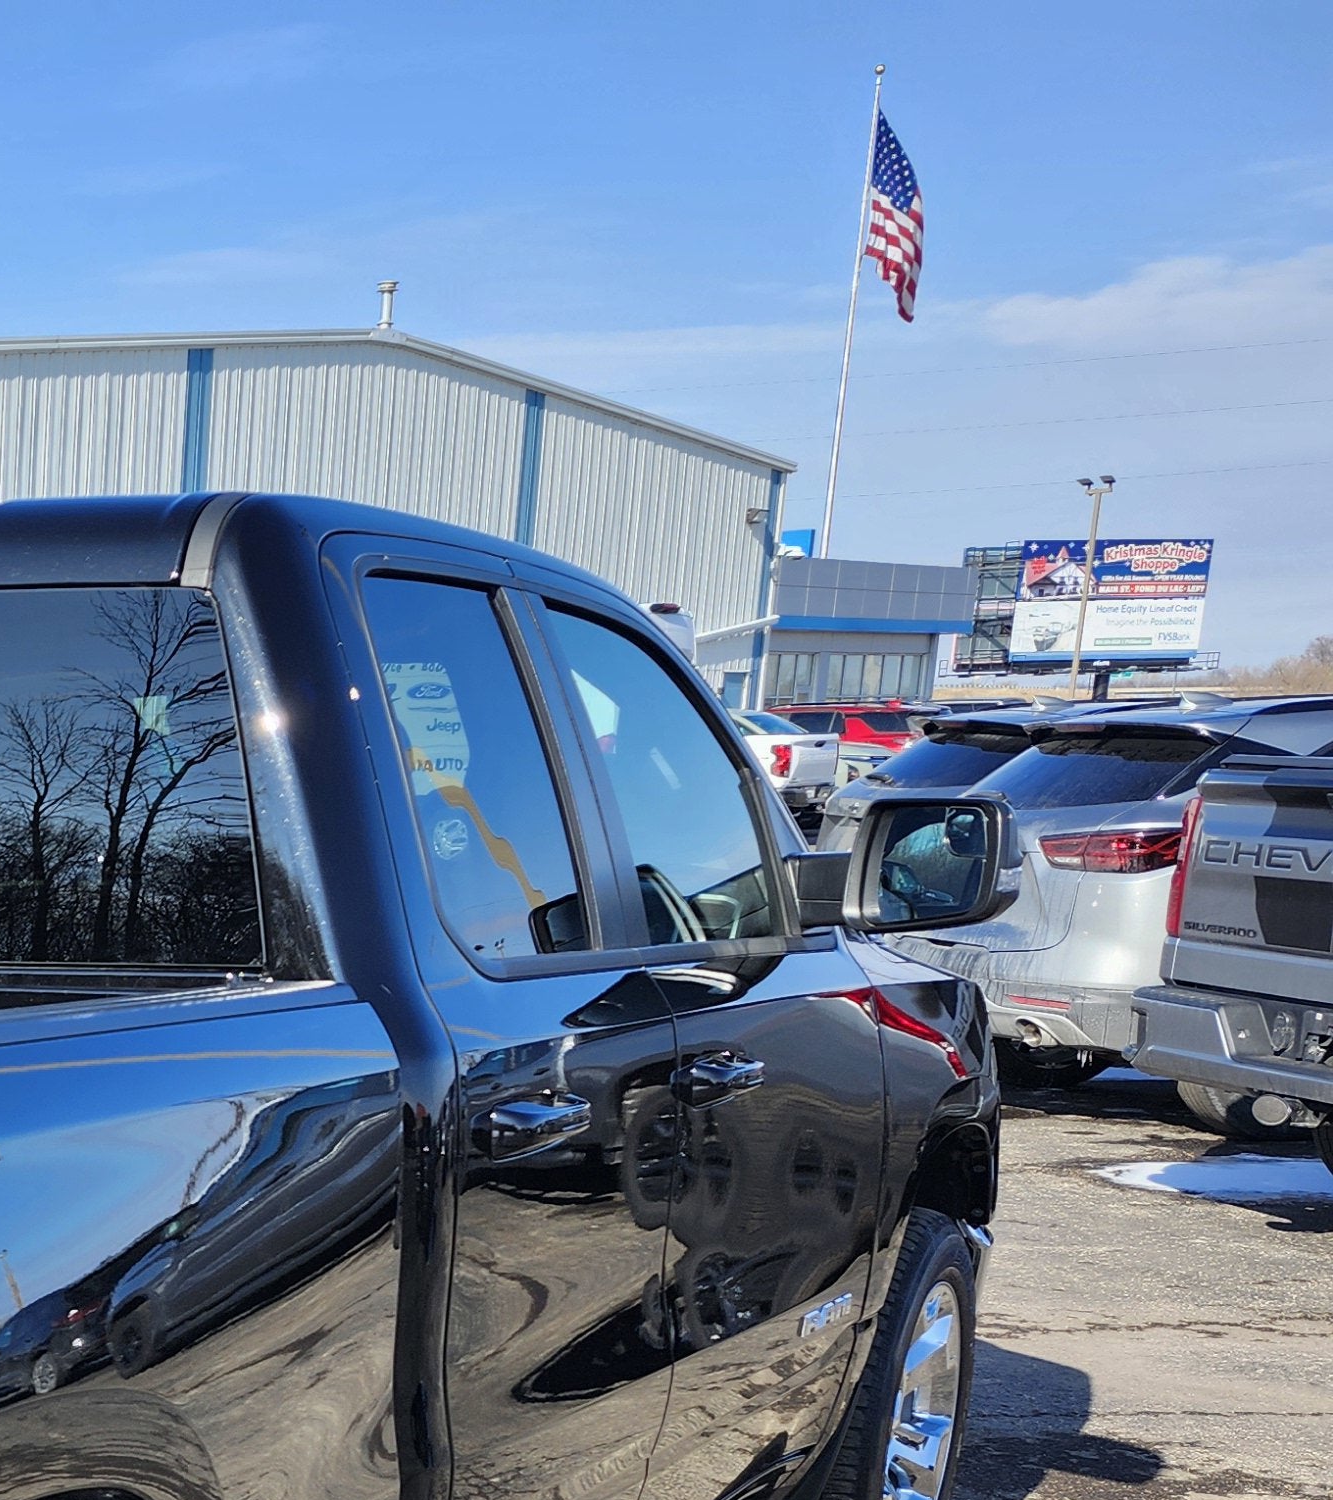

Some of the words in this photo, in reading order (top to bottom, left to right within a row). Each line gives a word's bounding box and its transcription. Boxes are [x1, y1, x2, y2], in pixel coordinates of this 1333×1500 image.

[1105, 545, 1159, 561] Kristmas
[1162, 542, 1205, 560] Kringle
[1133, 559, 1177, 572] Shoppe
[1098, 585, 1119, 593] MAIN
[1119, 585, 1131, 593] ST.
[1134, 585, 1155, 593] FOND
[1156, 585, 1168, 593] DU
[1169, 585, 1184, 593] LAC
[1186, 585, 1206, 593] LEFT
[1096, 605, 1119, 613] Home
[1121, 604, 1147, 615] Equity
[1149, 605, 1165, 613] Line
[1165, 604, 1174, 612] of
[1174, 604, 1197, 612] Credit
[1106, 619, 1134, 628] Imagine
[1136, 618, 1149, 626] the
[1150, 618, 1196, 626] Possibilities!
[1157, 632, 1190, 641] FVSBank
[426, 718, 461, 734] Jeep
[1184, 921, 1257, 939] SILVERADO
[797, 1292, 852, 1338] RAM
